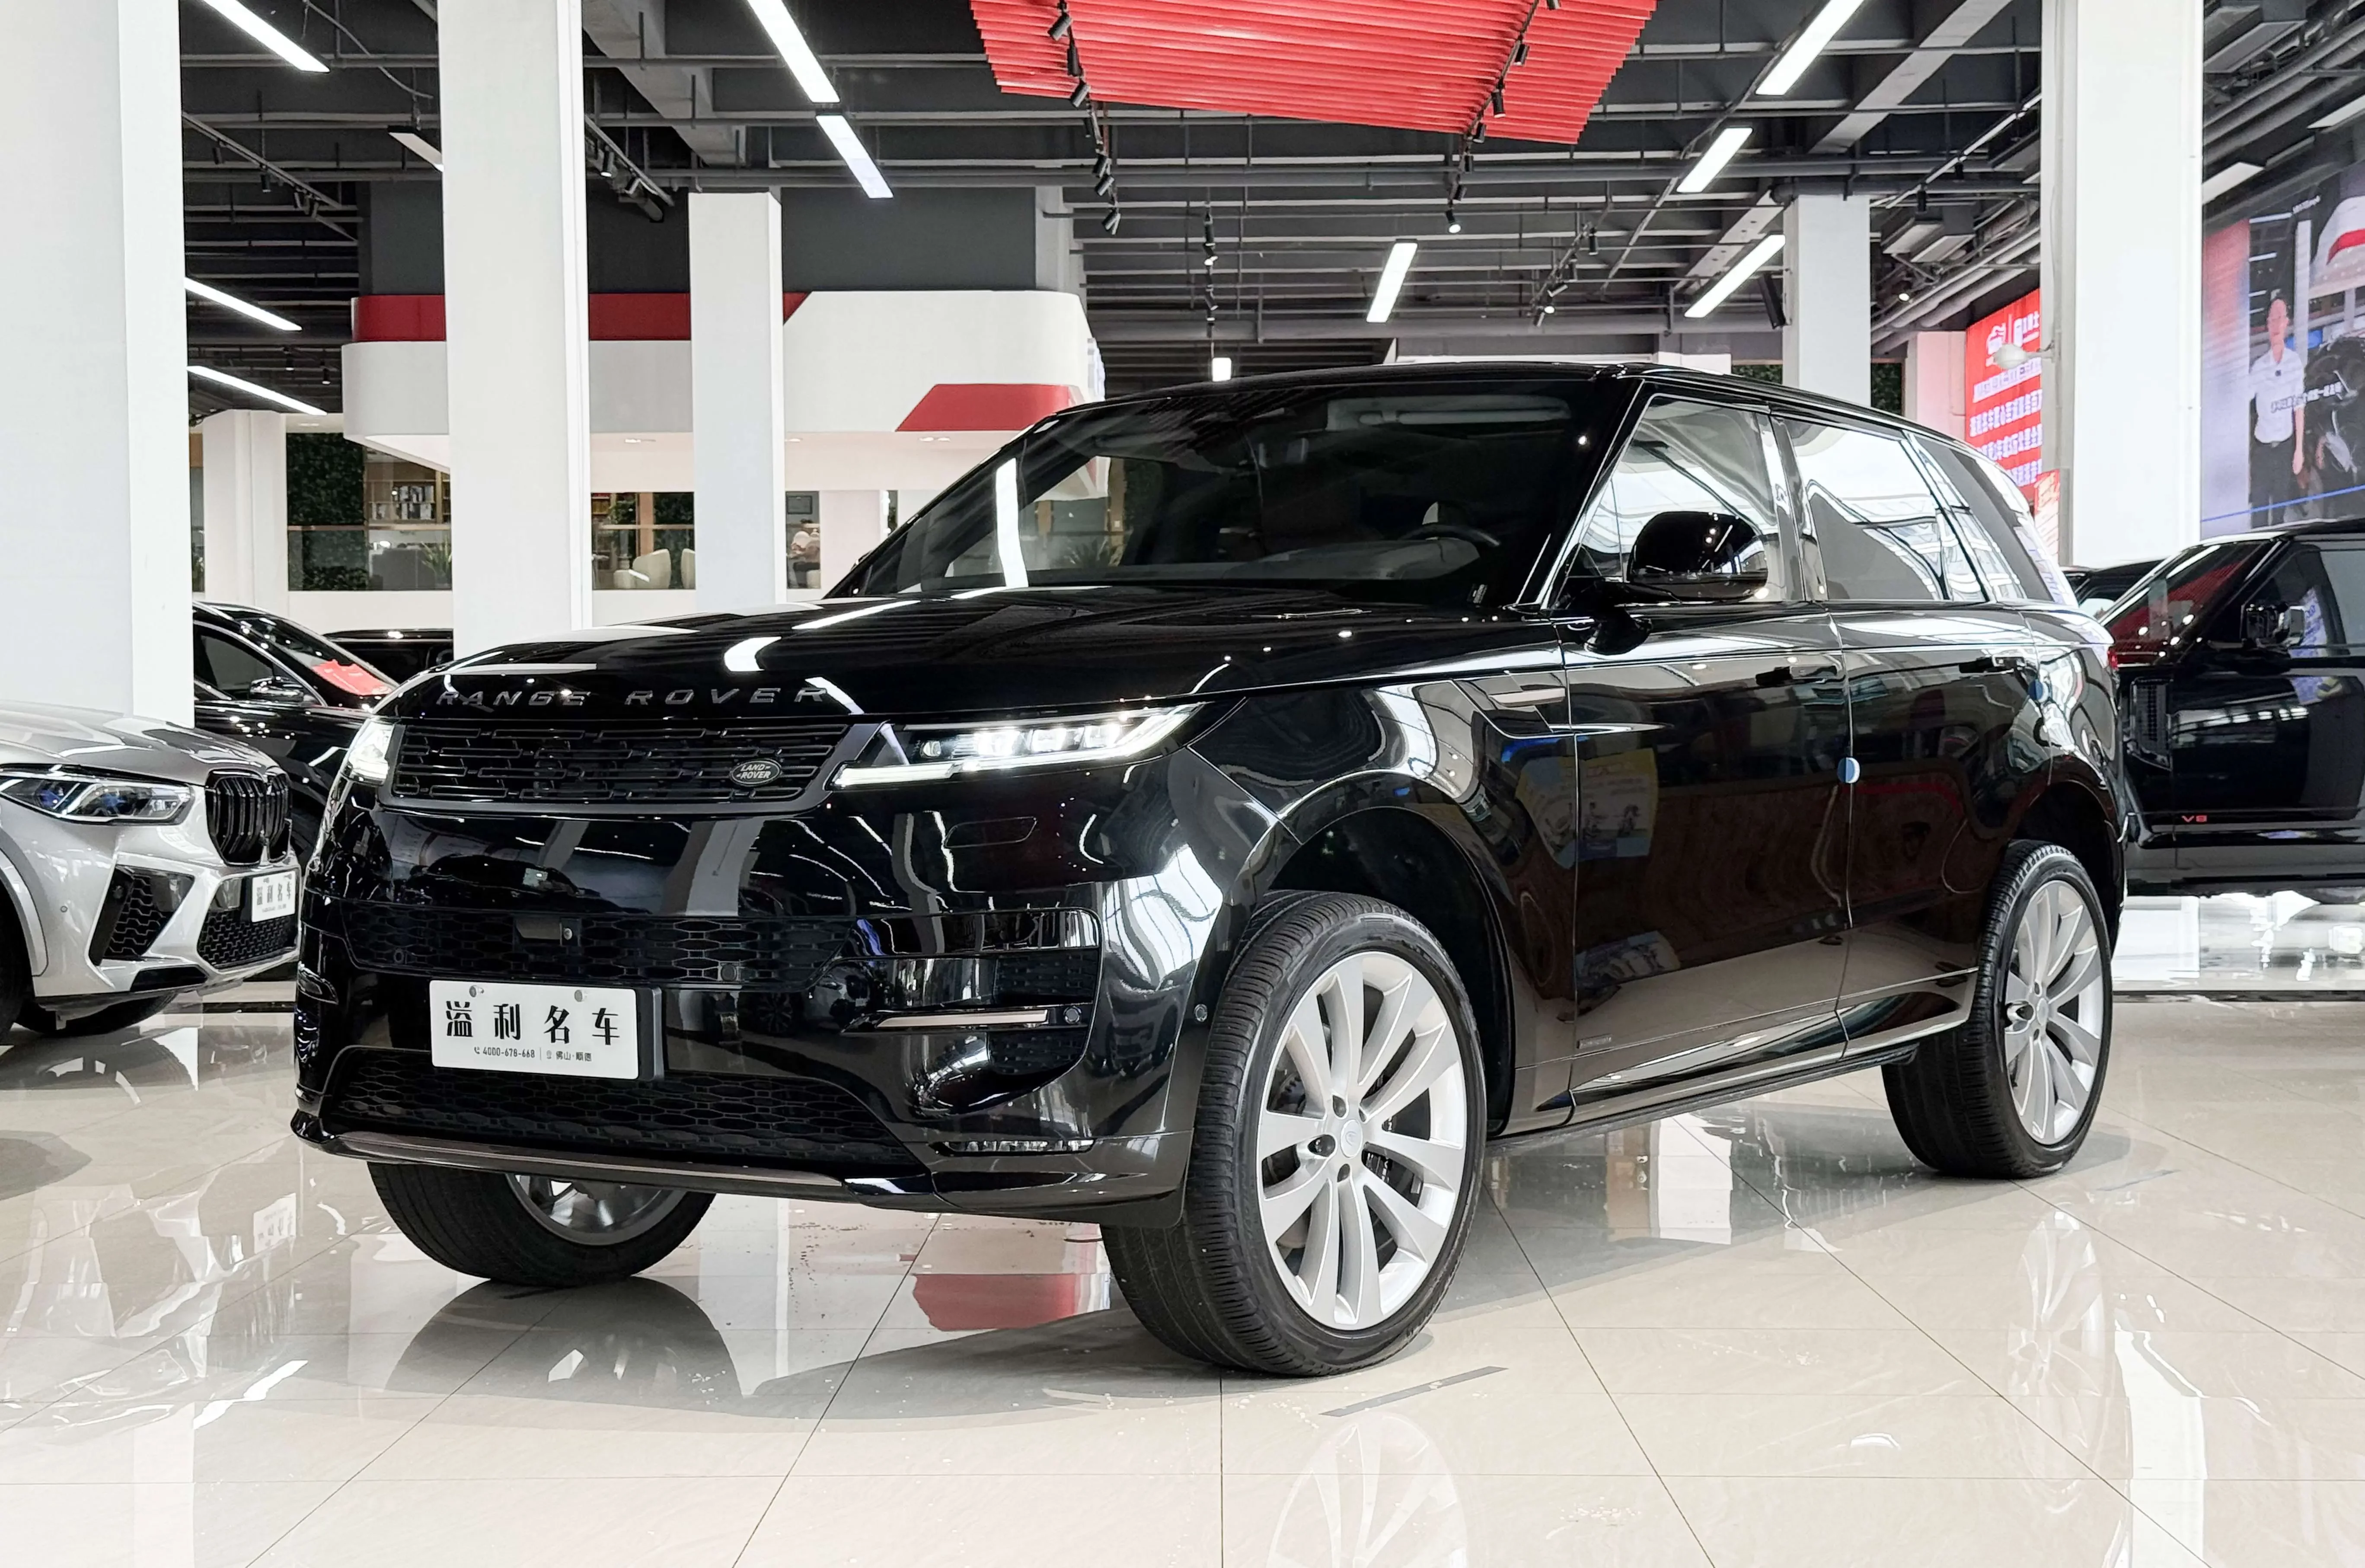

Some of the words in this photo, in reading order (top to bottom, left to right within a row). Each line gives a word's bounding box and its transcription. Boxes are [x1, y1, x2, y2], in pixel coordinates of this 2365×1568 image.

[436, 691, 591, 706] RANGE
[625, 688, 827, 706] ROVER
[740, 771, 771, 779] ROVER
[446, 1001, 620, 1045] 溢利名车
[483, 1047, 535, 1058] 4000-678-668
